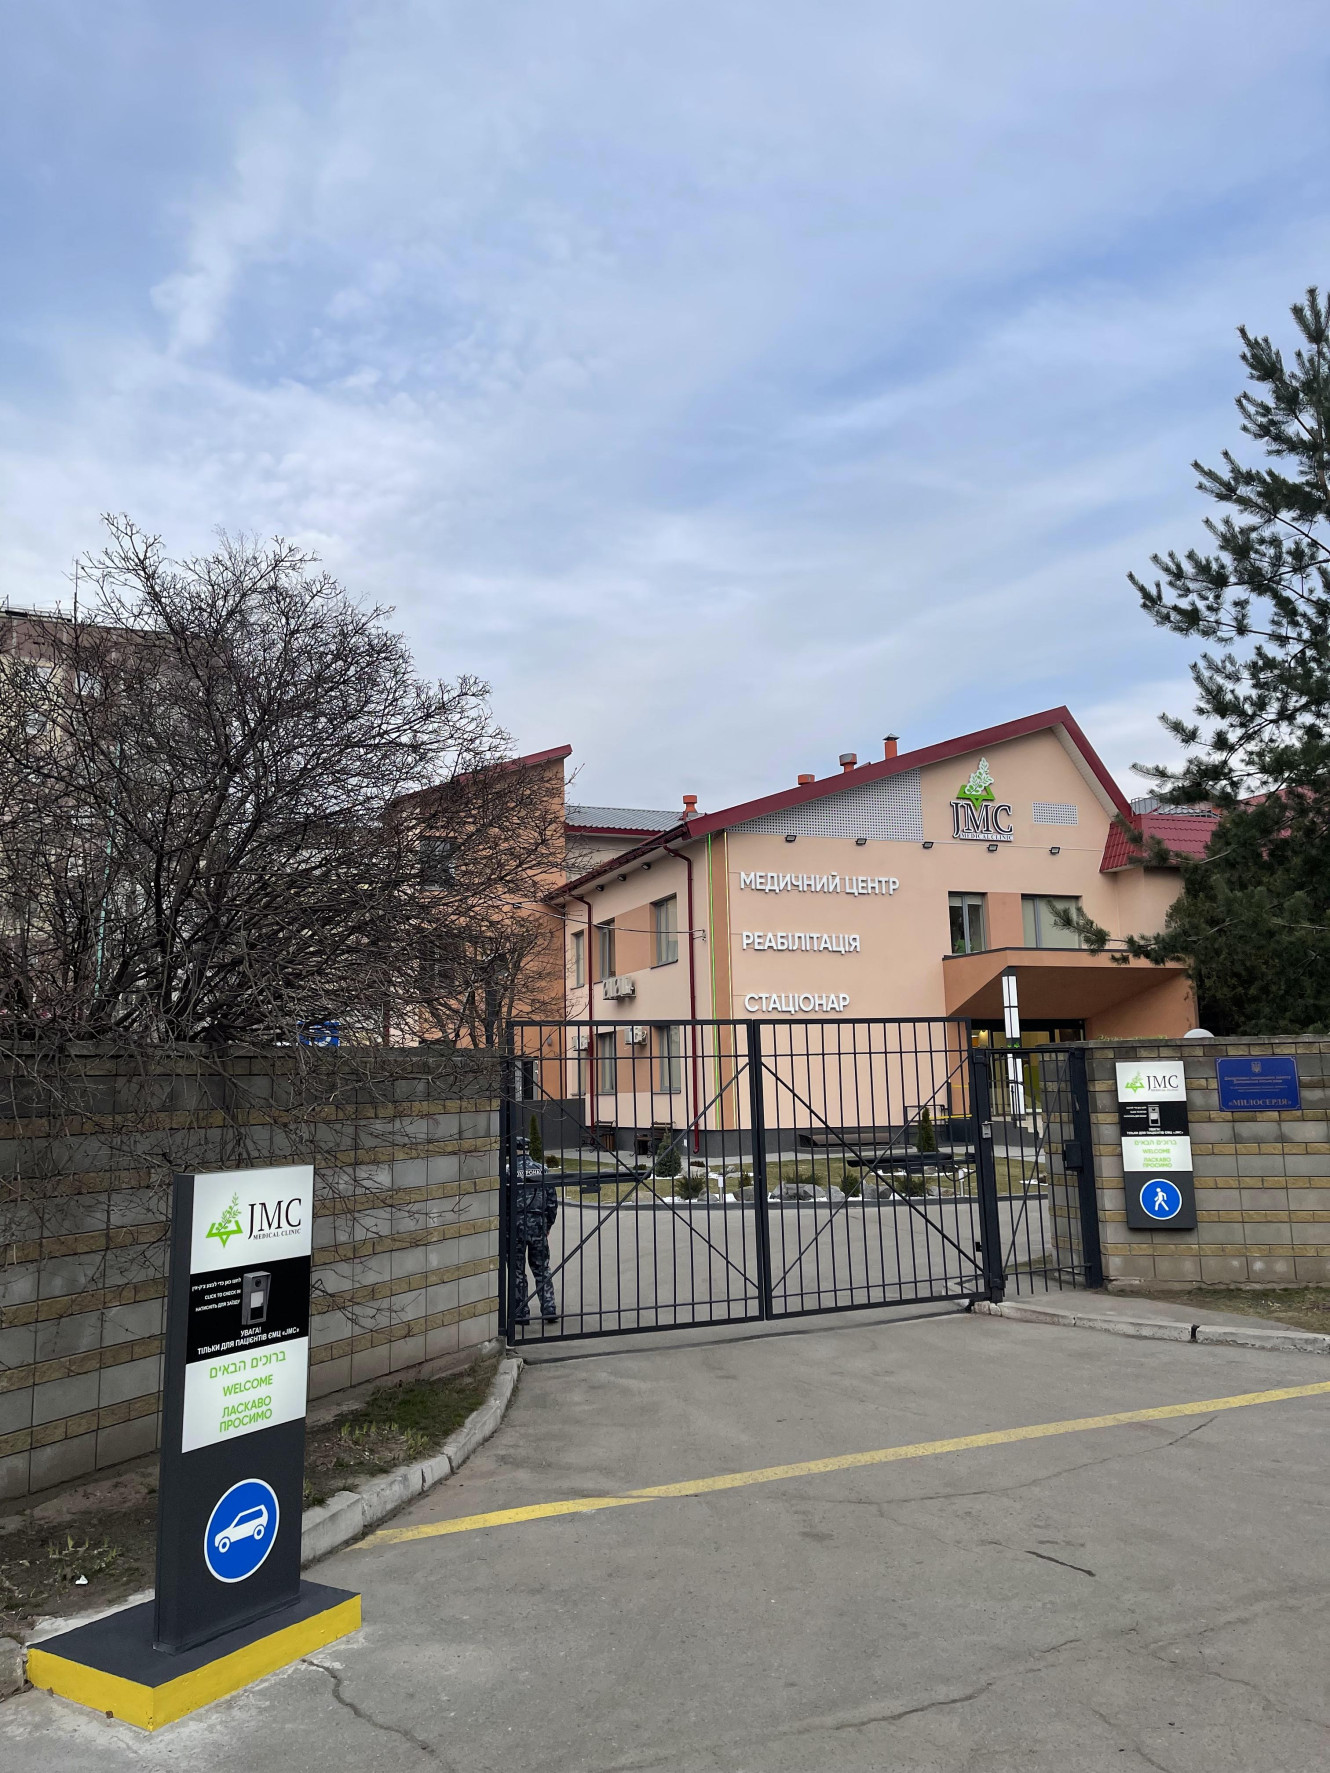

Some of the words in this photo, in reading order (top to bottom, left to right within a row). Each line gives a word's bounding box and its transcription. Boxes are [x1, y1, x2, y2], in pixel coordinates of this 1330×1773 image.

[950, 800, 1014, 838] JMC
[961, 832, 989, 840] MEDICAL
[740, 872, 841, 893] МЕДИЧНИЙ
[845, 876, 899, 896] ЦЕНТР
[742, 931, 861, 955] РЕАБІЛІТАЦІЯ
[744, 993, 850, 1015] СТАЦІОНАР
[1146, 1075, 1179, 1091] JMC
[248, 1198, 302, 1240] JMC
[253, 1231, 280, 1240] MEDICAL
[281, 1228, 301, 1236] CLINIC
[197, 1344, 220, 1355] ТІЛЬКИ
[220, 1340, 235, 1351] ДЛЯ
[235, 1333, 267, 1347] ПАЦІЄНТІВ
[268, 1330, 282, 1340] ЄМЦ
[282, 1326, 300, 1336] «JMC»
[240, 1326, 262, 1337] УВАГА!
[209, 1360, 246, 1379] הבאים
[251, 1350, 286, 1369] ברוכים
[222, 1374, 273, 1397] WELCOME
[221, 1395, 272, 1418] ЛАСКАВО
[219, 1408, 273, 1433] ПРОСИМО
